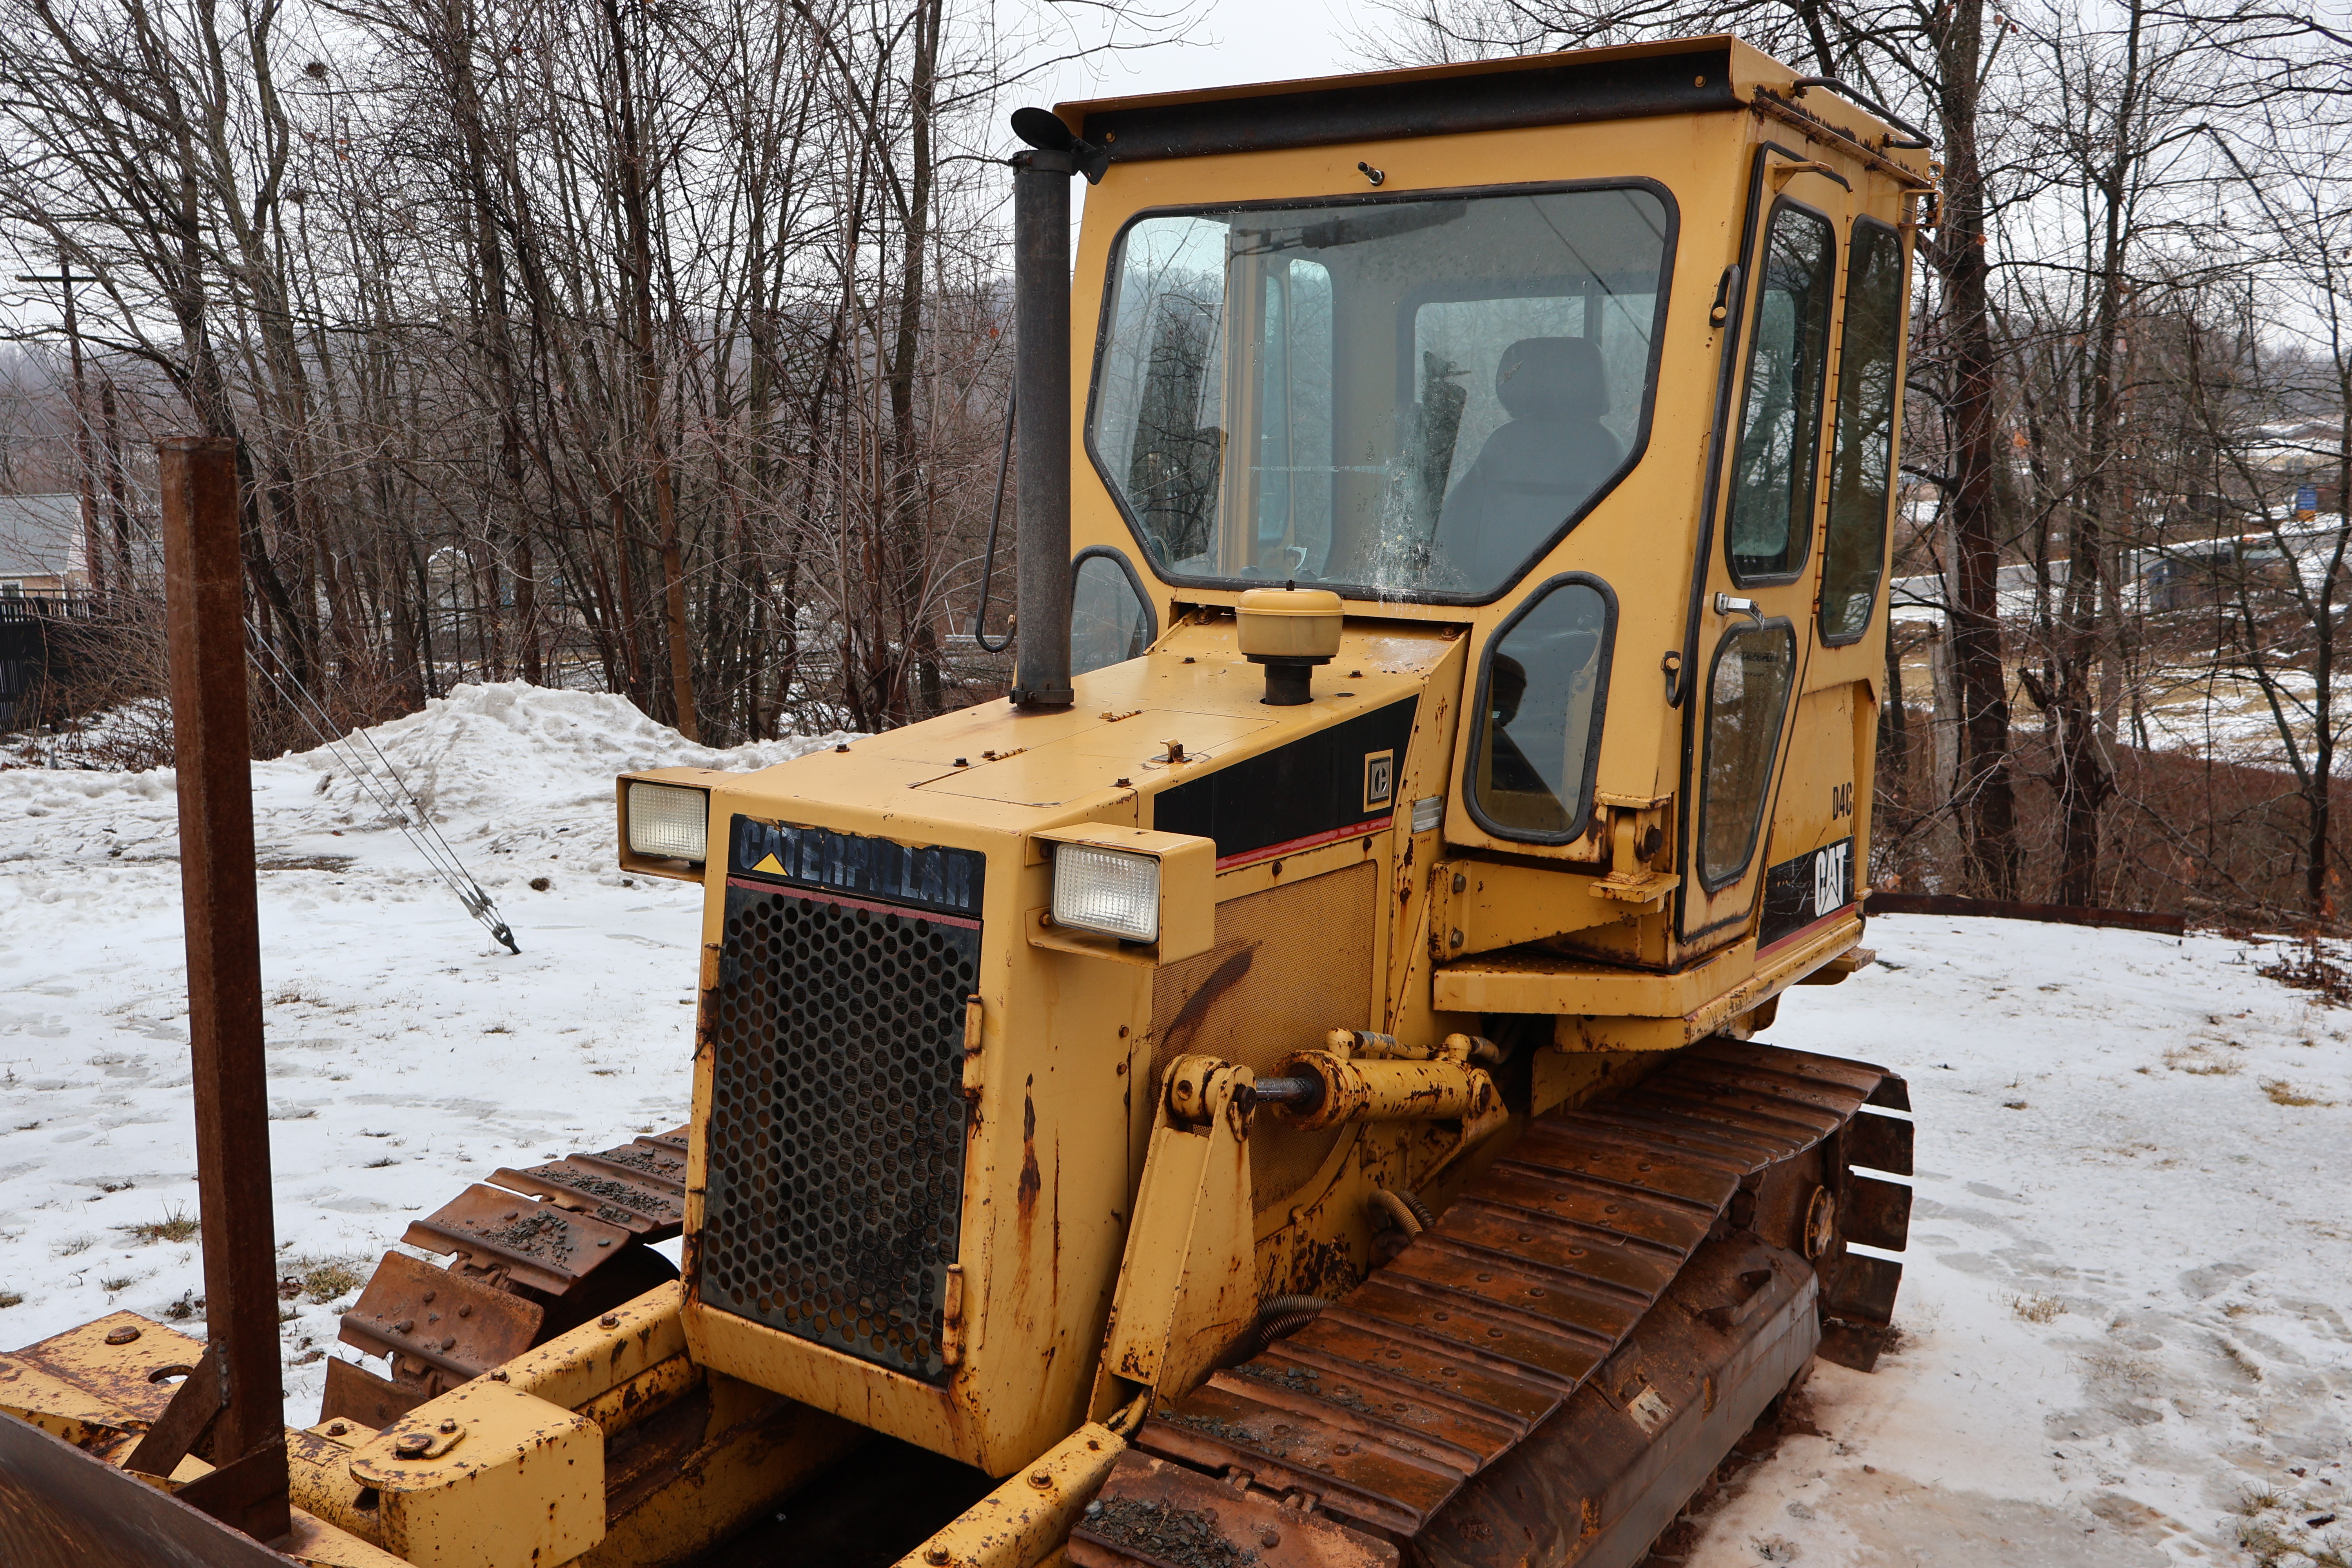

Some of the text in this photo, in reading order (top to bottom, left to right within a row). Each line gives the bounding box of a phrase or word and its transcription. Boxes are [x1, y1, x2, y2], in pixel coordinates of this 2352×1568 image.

[1833, 781, 1852, 820] D4C
[740, 821, 971, 908] CATERPILLAR
[1815, 842, 1847, 917] CAT
